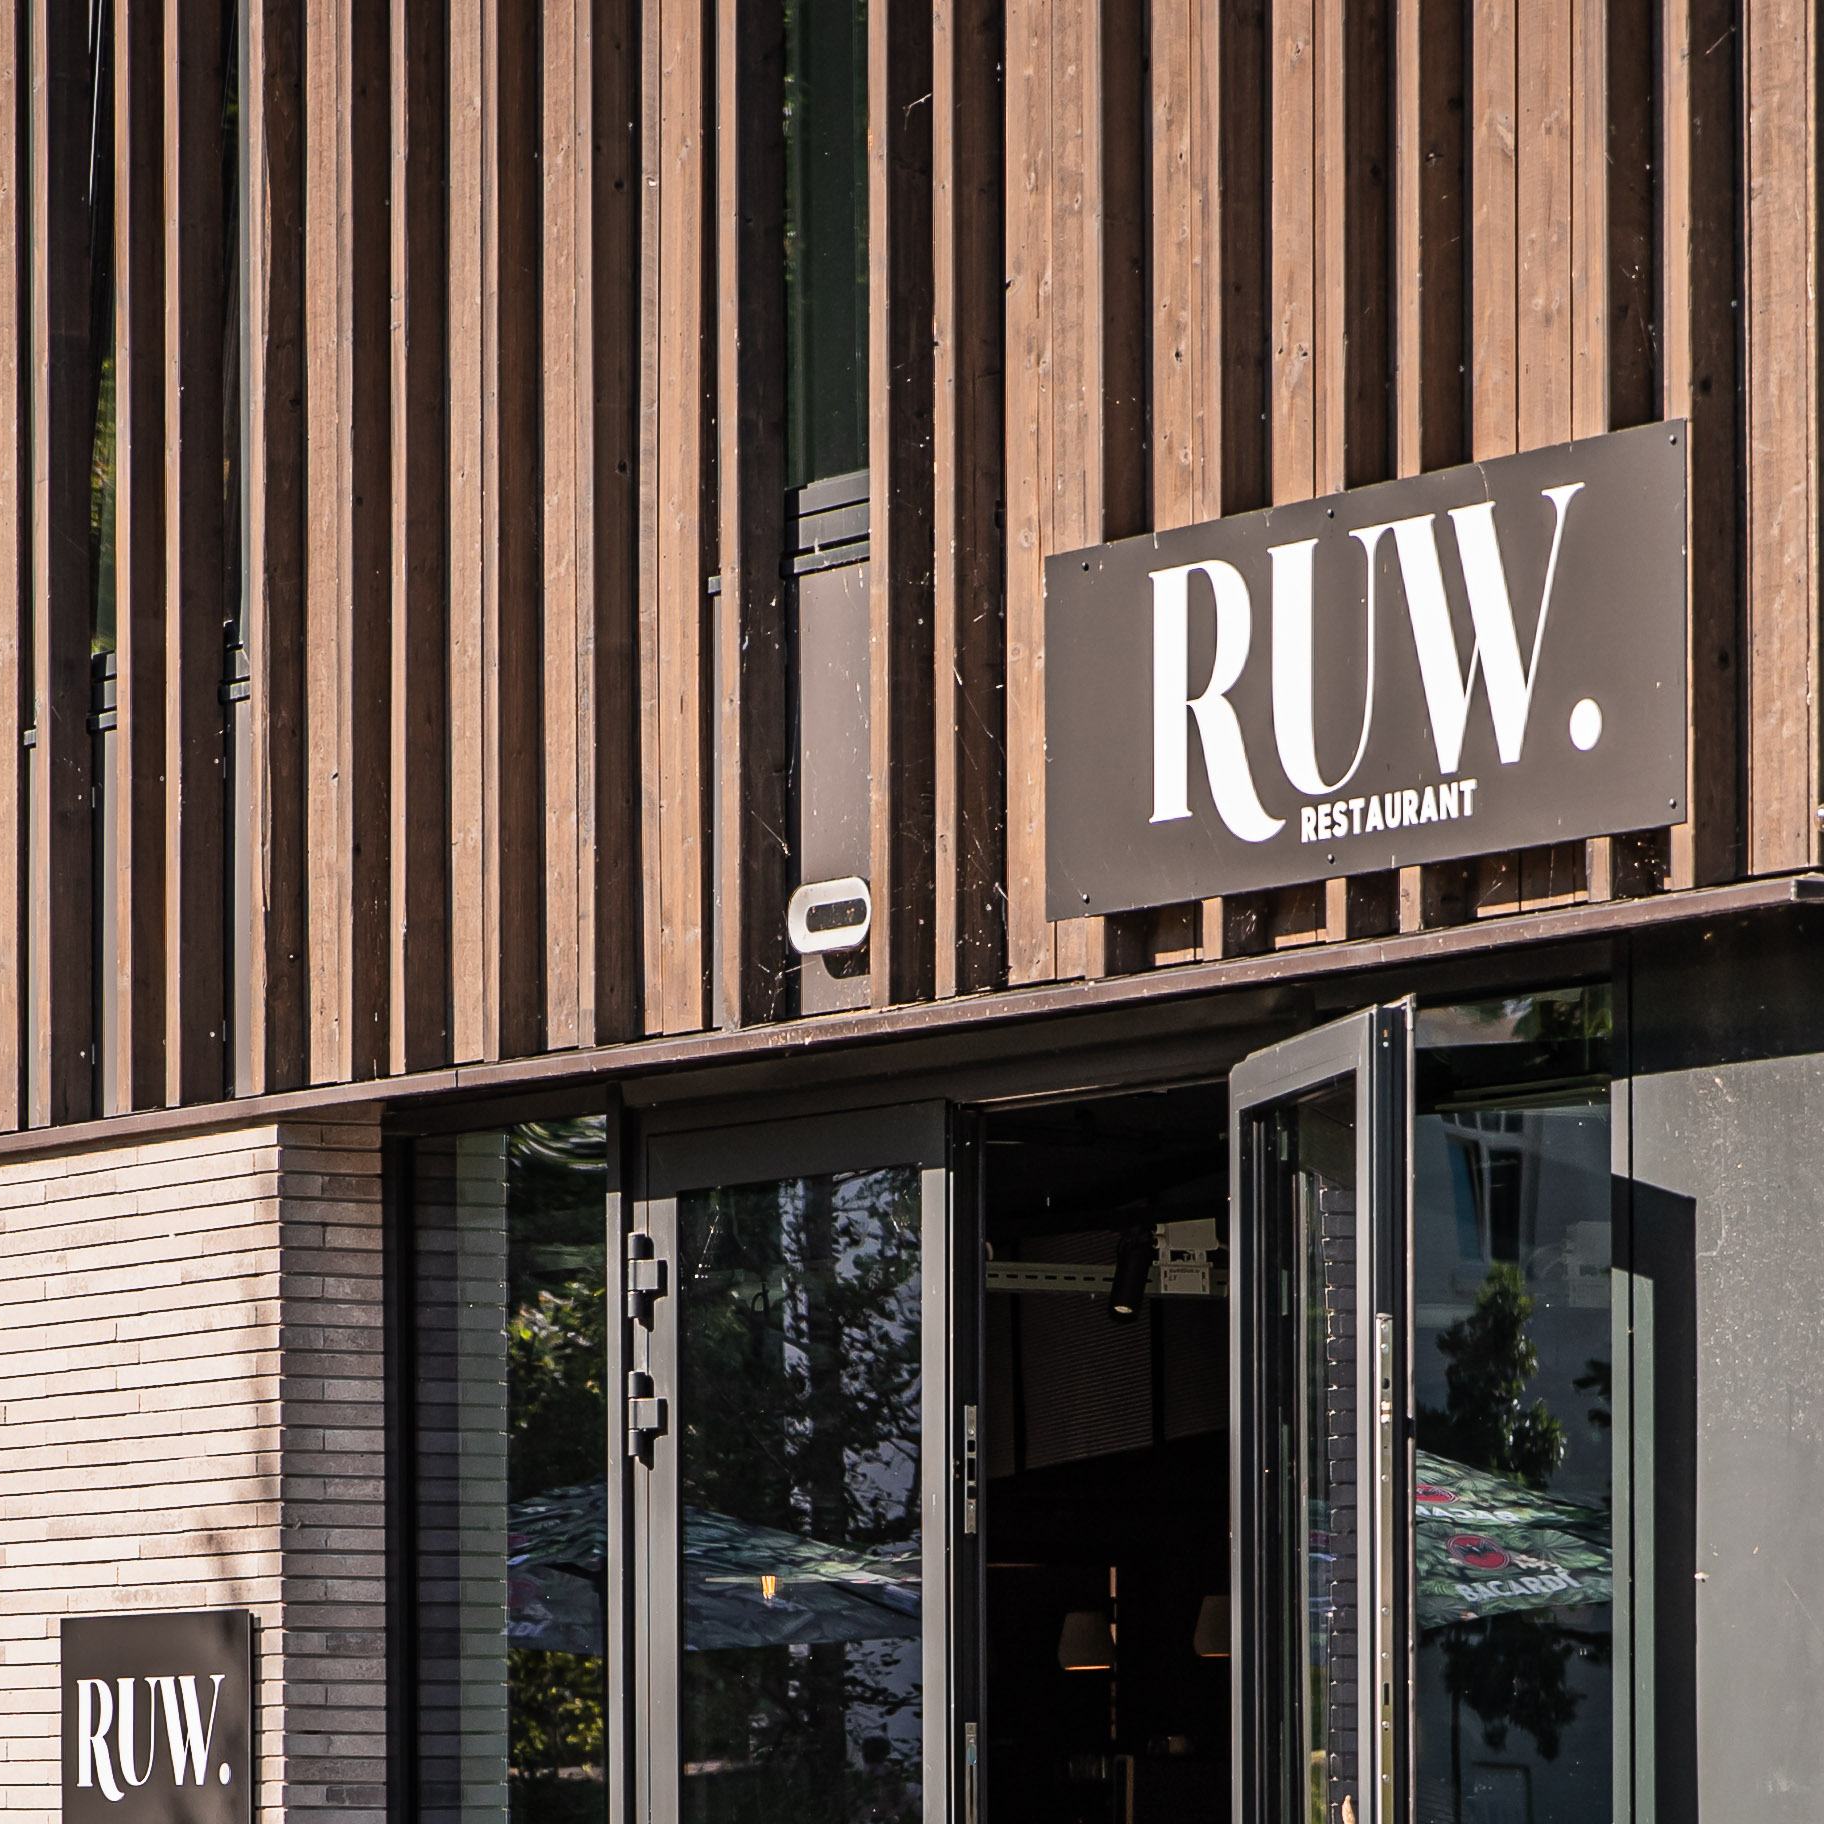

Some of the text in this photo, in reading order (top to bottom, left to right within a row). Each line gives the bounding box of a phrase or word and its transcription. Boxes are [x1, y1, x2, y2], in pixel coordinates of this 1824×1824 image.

[1148, 482, 1602, 842] RUW.
[1300, 778, 1478, 843] RESTAURANT
[76, 1674, 231, 1801] RUW.
